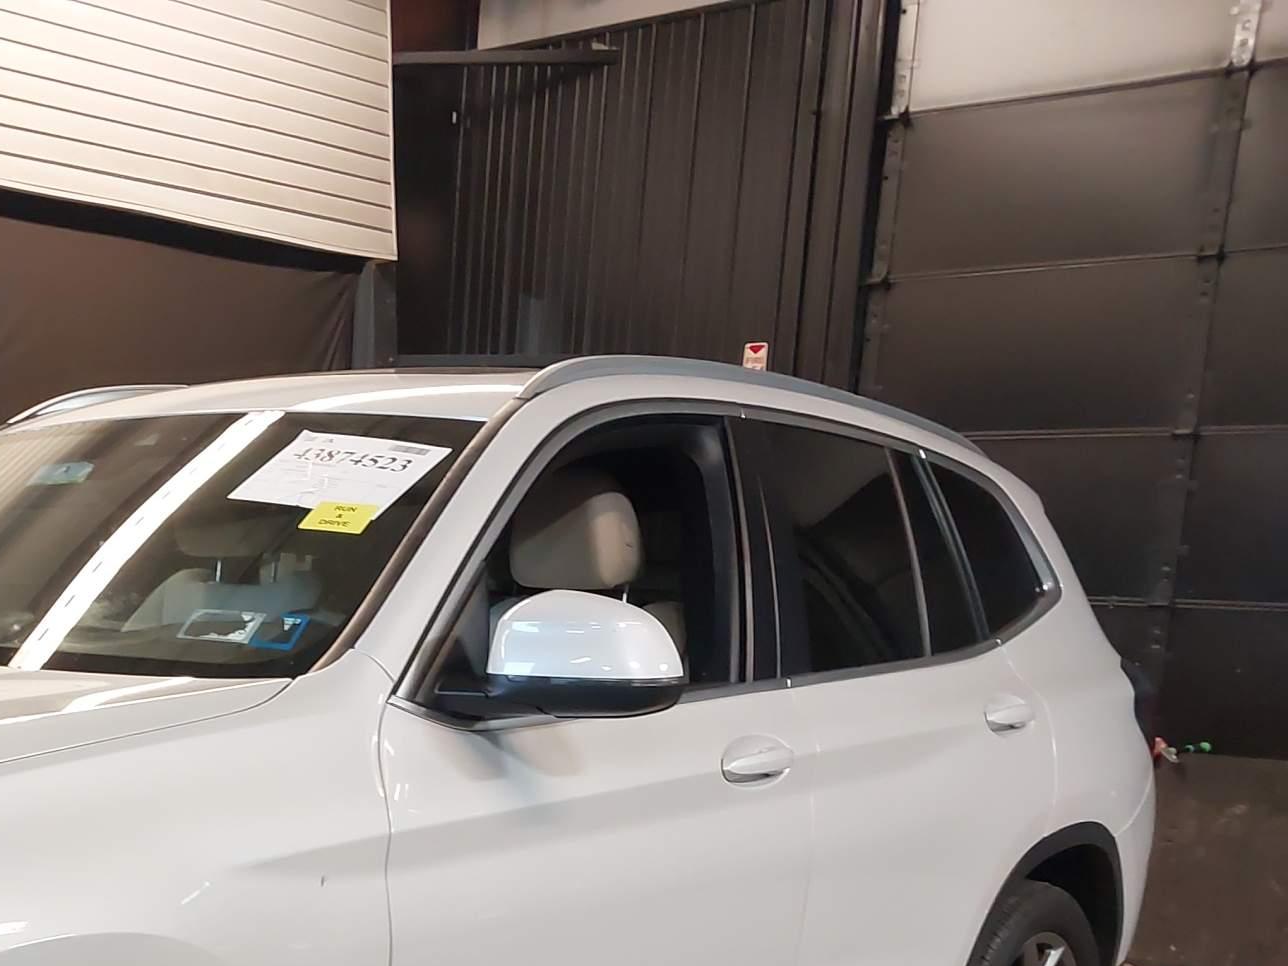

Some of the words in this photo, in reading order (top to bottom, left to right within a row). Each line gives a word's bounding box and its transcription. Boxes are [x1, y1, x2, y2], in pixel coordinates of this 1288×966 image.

[294, 447, 413, 472] 43874523
[334, 505, 358, 513] RUN
[318, 518, 352, 527] DRIVE
